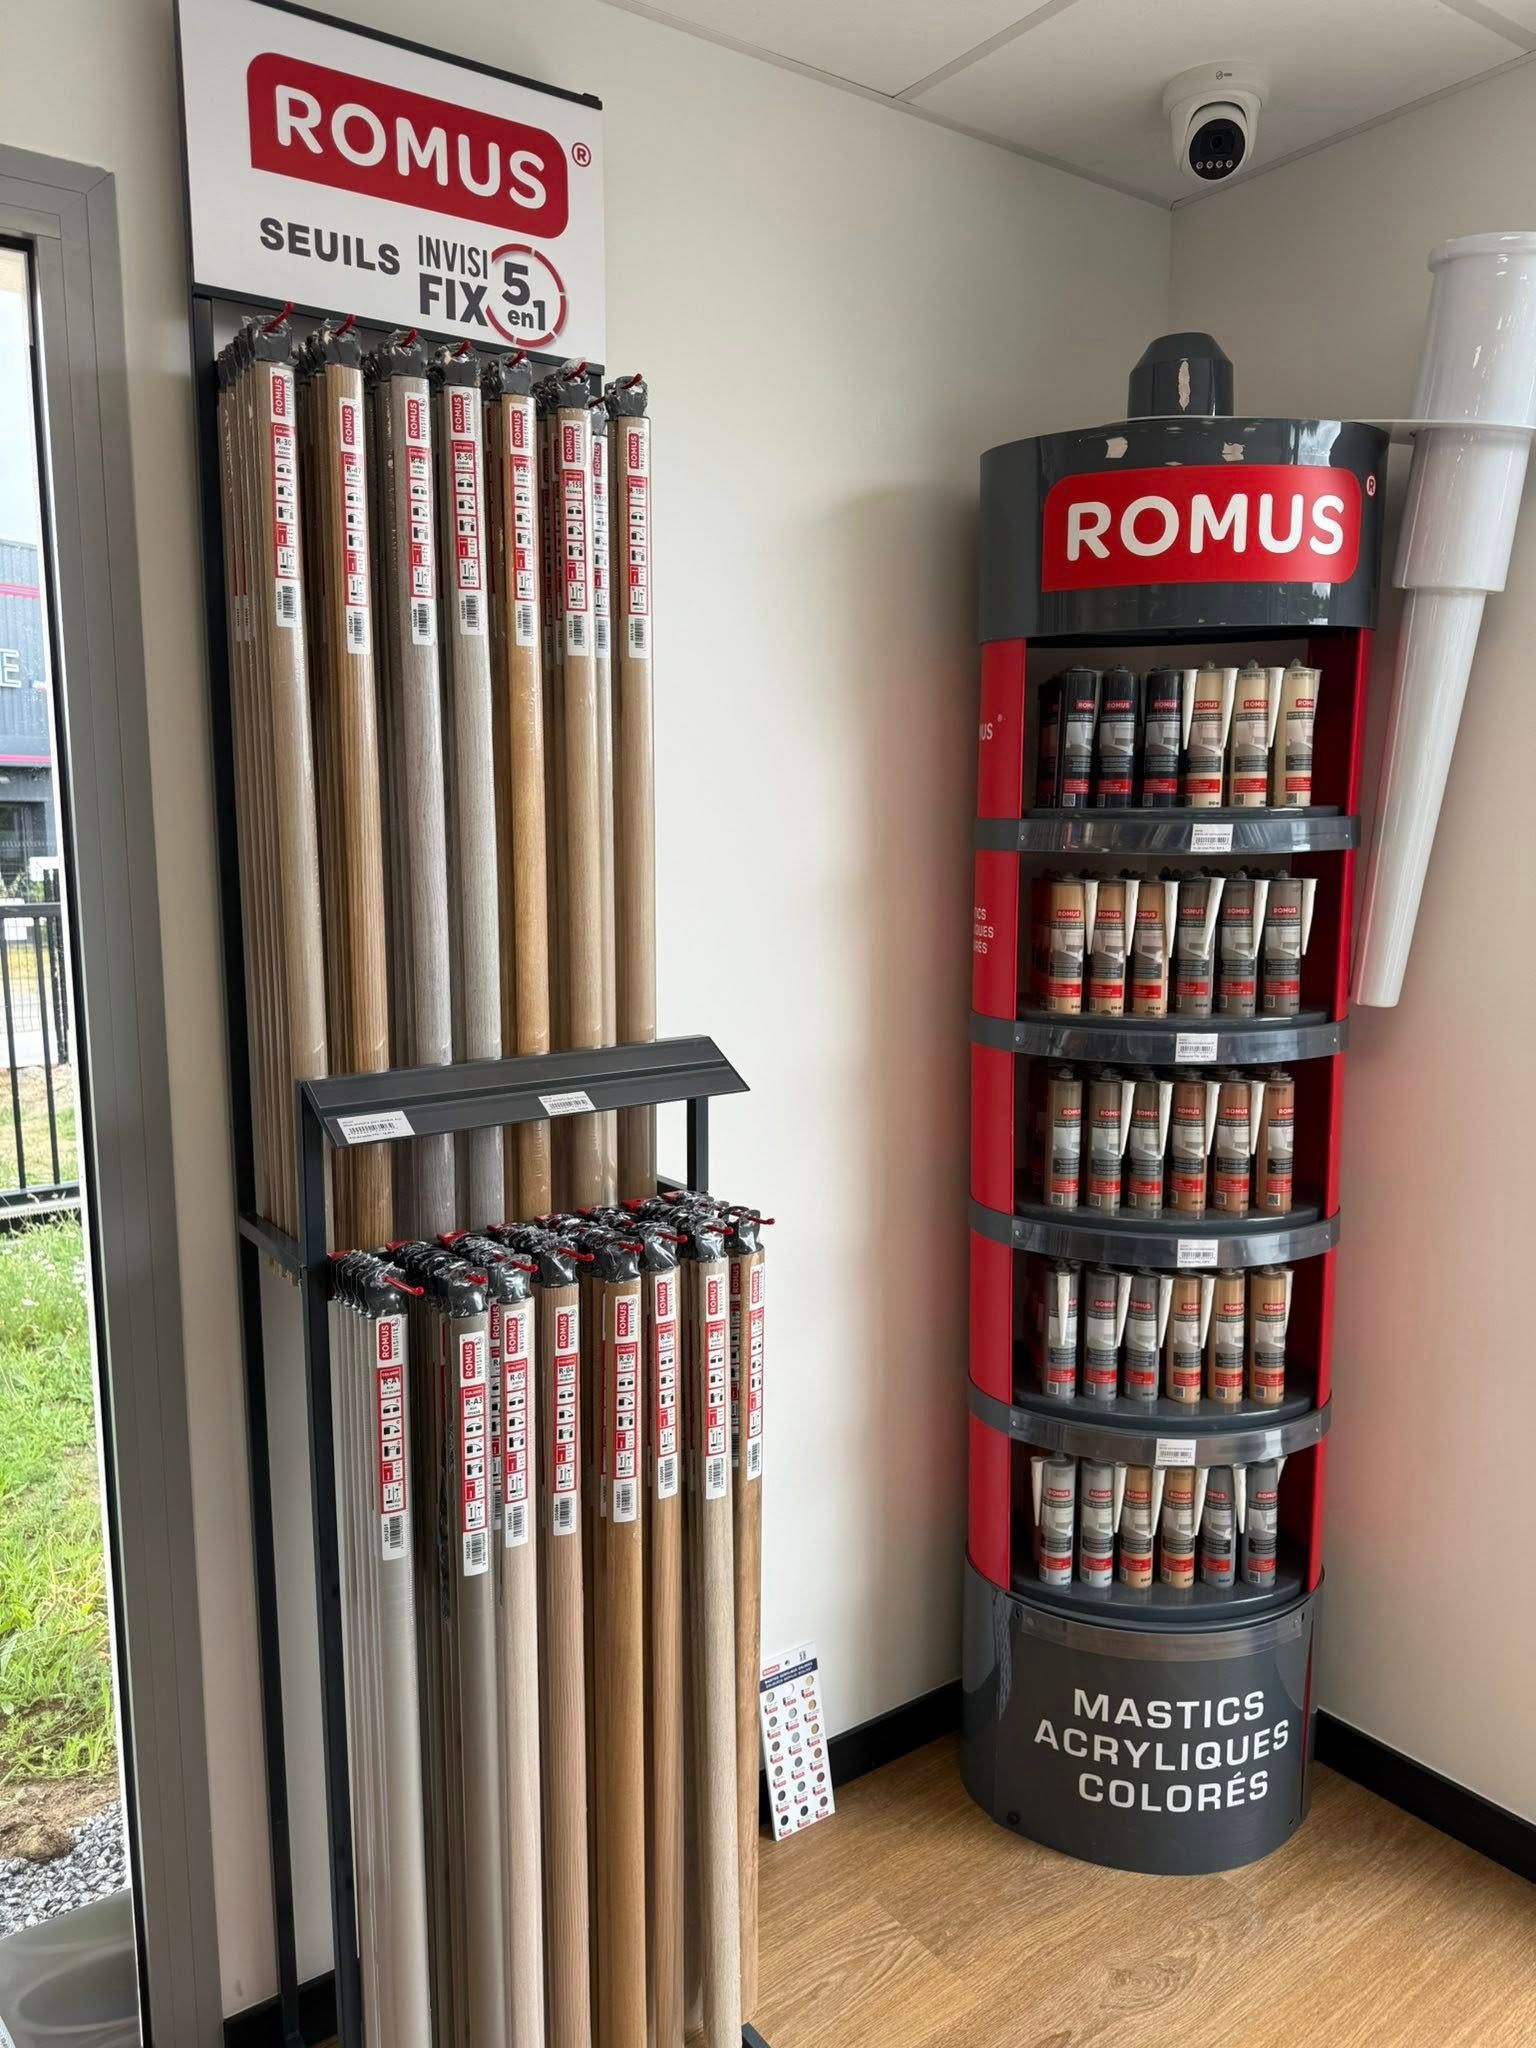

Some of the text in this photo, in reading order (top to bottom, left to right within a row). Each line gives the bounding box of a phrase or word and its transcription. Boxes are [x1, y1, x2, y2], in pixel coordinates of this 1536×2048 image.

[274, 83, 547, 210] ROMUS
[260, 217, 400, 275] SEUILS
[418, 235, 488, 280] INVISI
[419, 273, 488, 328] FIX
[501, 263, 531, 306] 5
[274, 376, 284, 415] ROMUS
[453, 397, 464, 432] ROMUS
[344, 406, 353, 445] ROMUS
[410, 402, 418, 438] ROMUS
[514, 413, 522, 447] ROMUS
[565, 428, 573, 462] ROMUS
[630, 435, 638, 468] ROMUS
[1066, 493, 1344, 562] ROMUS
[1077, 701, 1094, 709] ROMU
[658, 1283, 666, 1315] ROMUS
[709, 1281, 717, 1314] ROMUS
[381, 1324, 389, 1358] ROMUS
[559, 1314, 567, 1348] ROMUS
[1073, 1688, 1265, 1730] MASTICS
[1034, 1719, 1289, 1771] ACRYLIQUES
[1078, 1770, 1269, 1813] COLORÉS
